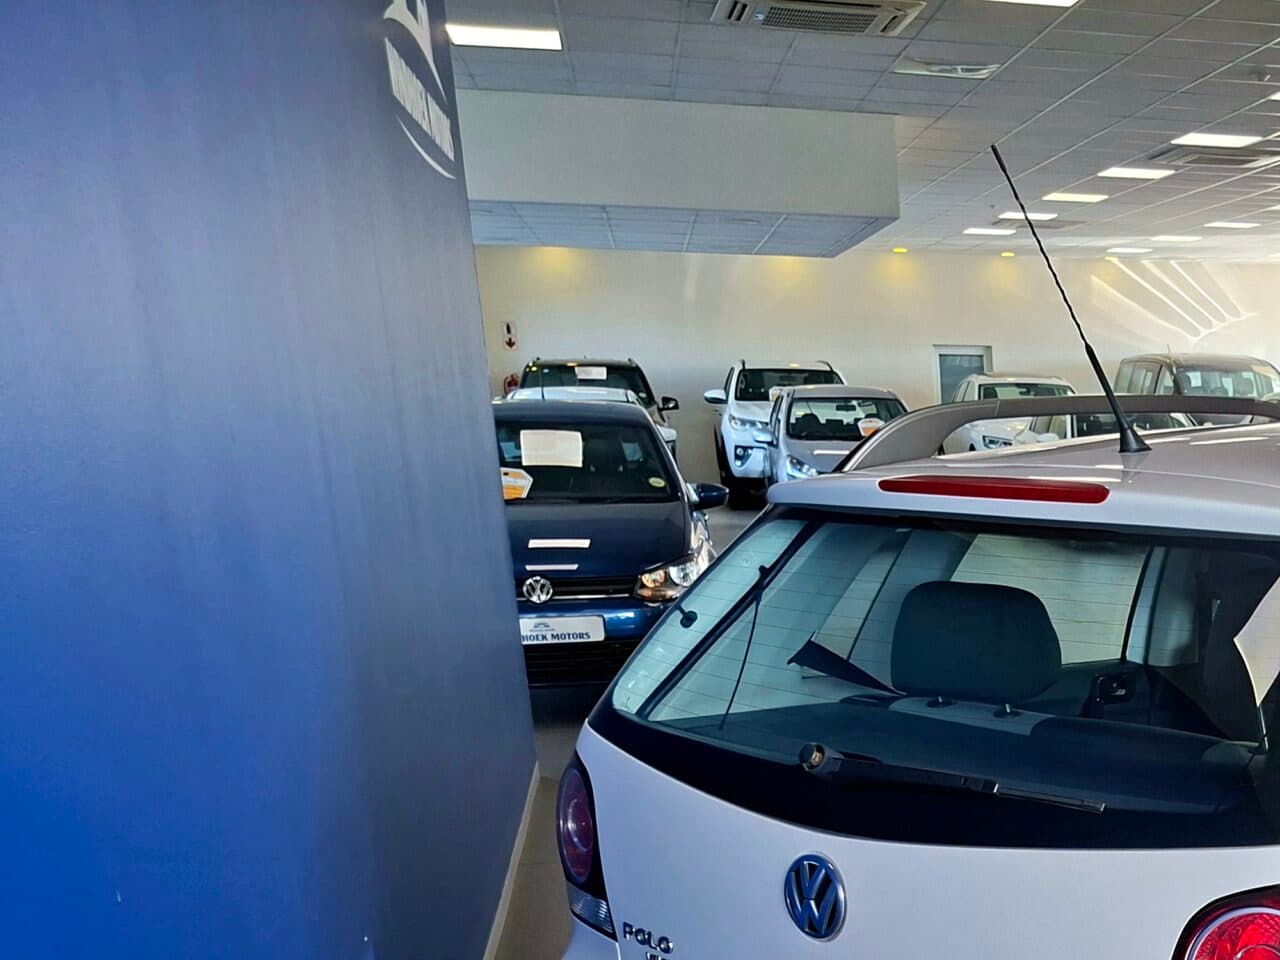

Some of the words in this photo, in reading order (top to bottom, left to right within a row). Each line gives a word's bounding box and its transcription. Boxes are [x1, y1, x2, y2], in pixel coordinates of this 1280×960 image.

[521, 634, 548, 642] HOEK
[551, 632, 591, 641] MOTORS
[623, 922, 673, 954] POLO
